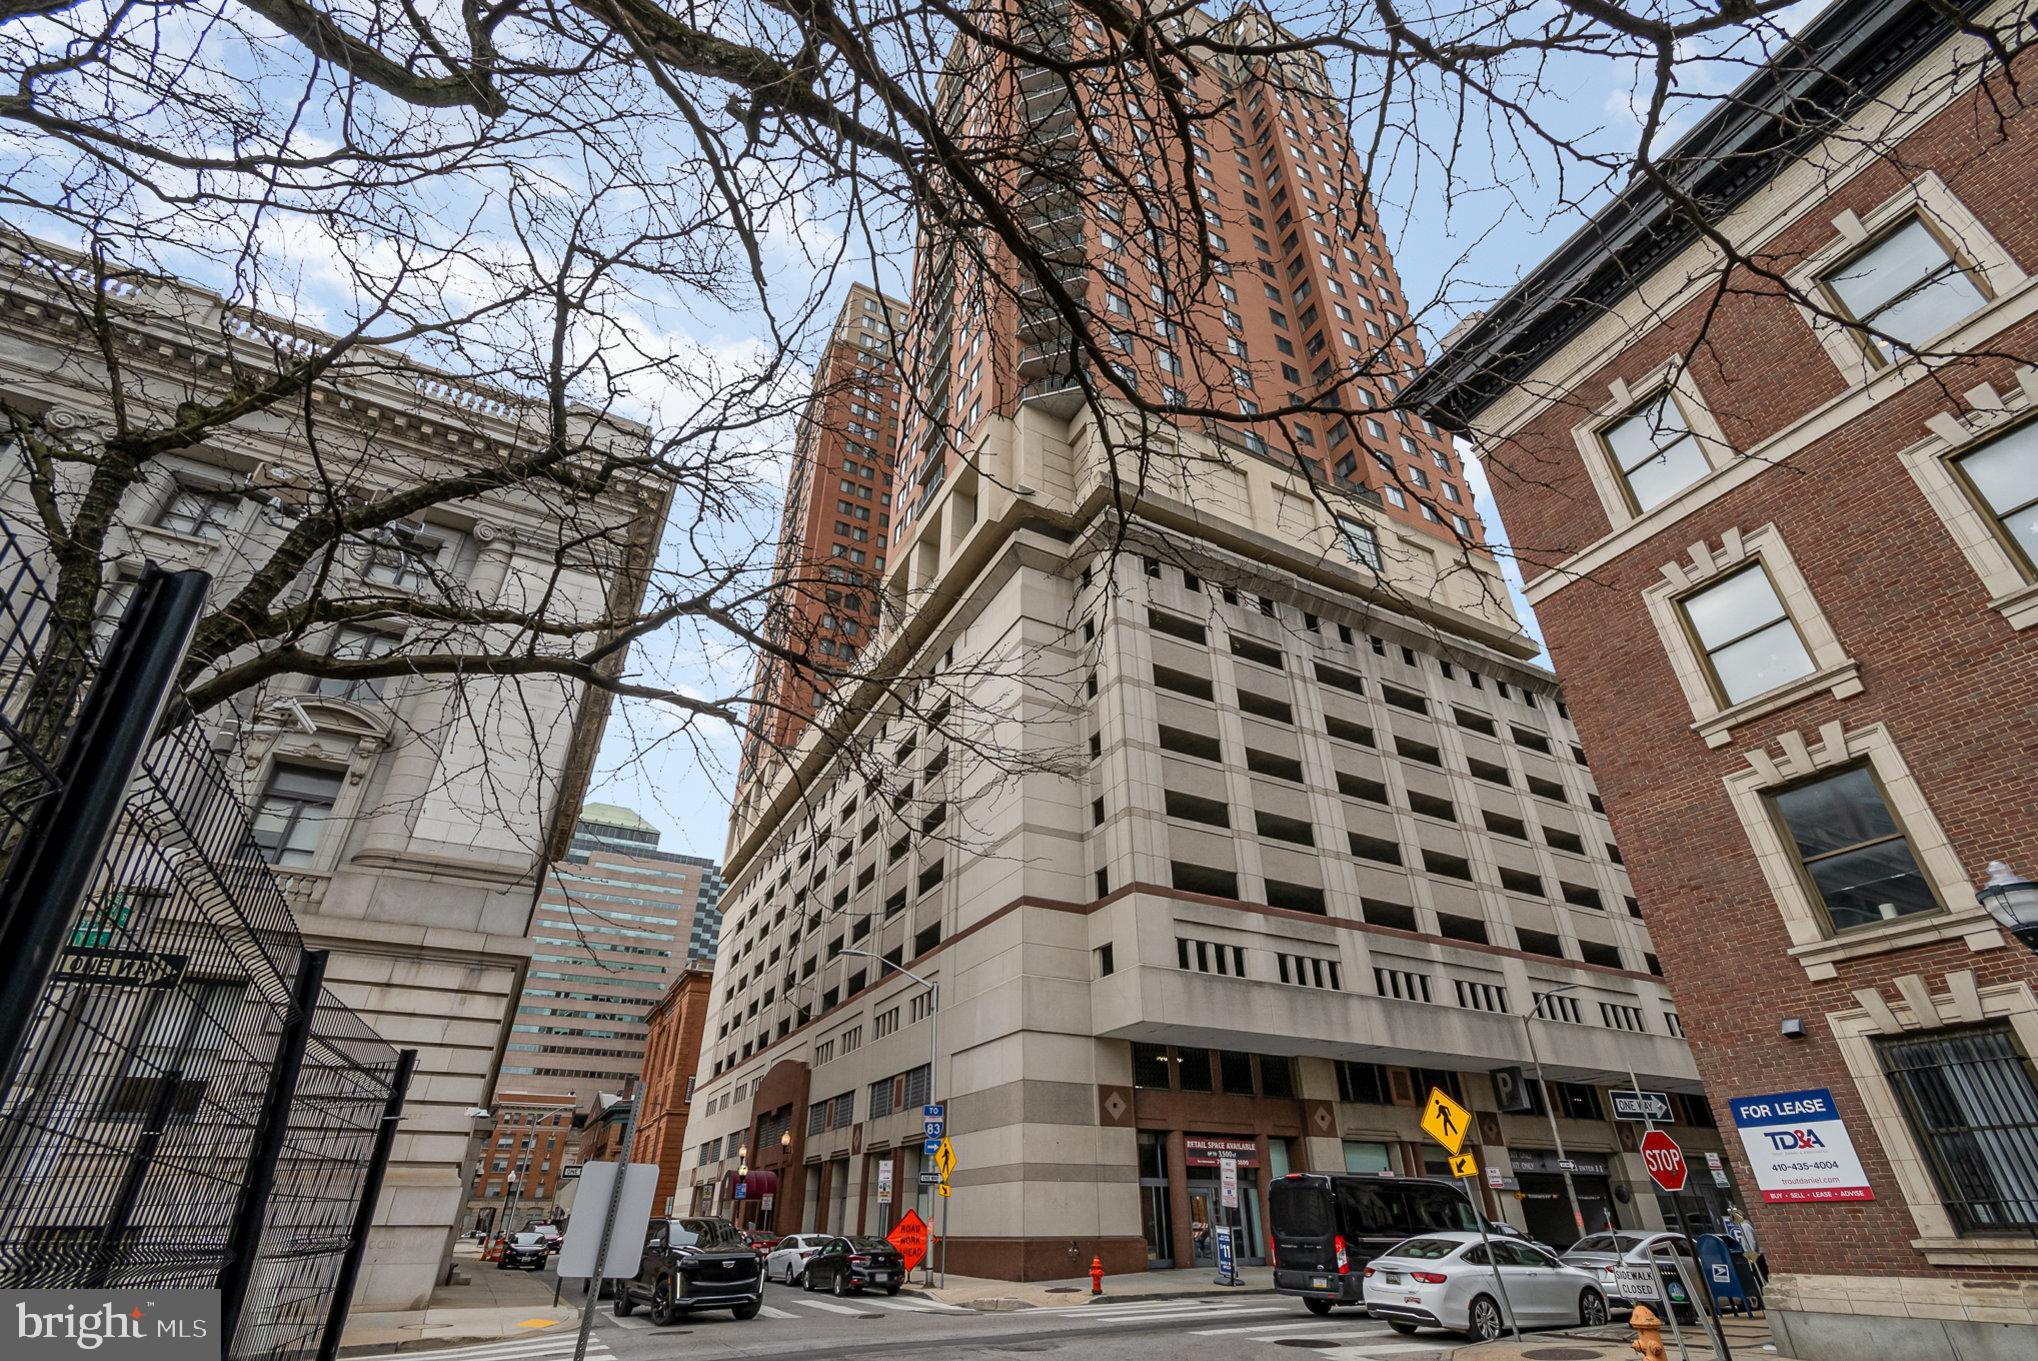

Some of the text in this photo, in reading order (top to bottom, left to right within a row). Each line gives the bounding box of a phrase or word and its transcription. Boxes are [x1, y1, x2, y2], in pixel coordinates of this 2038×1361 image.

[1495, 1071, 1512, 1106] P
[1618, 1100, 1637, 1111] ONE
[1740, 1098, 1826, 1119] FOR LEASE
[927, 1123, 940, 1135] 83
[1763, 1128, 1826, 1151] TD&A
[1187, 1140, 1256, 1151] RETAIL SPACE AVAILABLE
[1645, 1148, 1680, 1172] STOP
[1771, 1160, 1839, 1172] 410-435-4004
[1781, 1176, 1840, 1186] troutdaniel.com
[900, 1225, 920, 1233] ROAD
[900, 1236, 920, 1245] WORK
[1616, 1270, 1653, 1281] SIDEWALK
[1622, 1284, 1653, 1295] CLOSED
